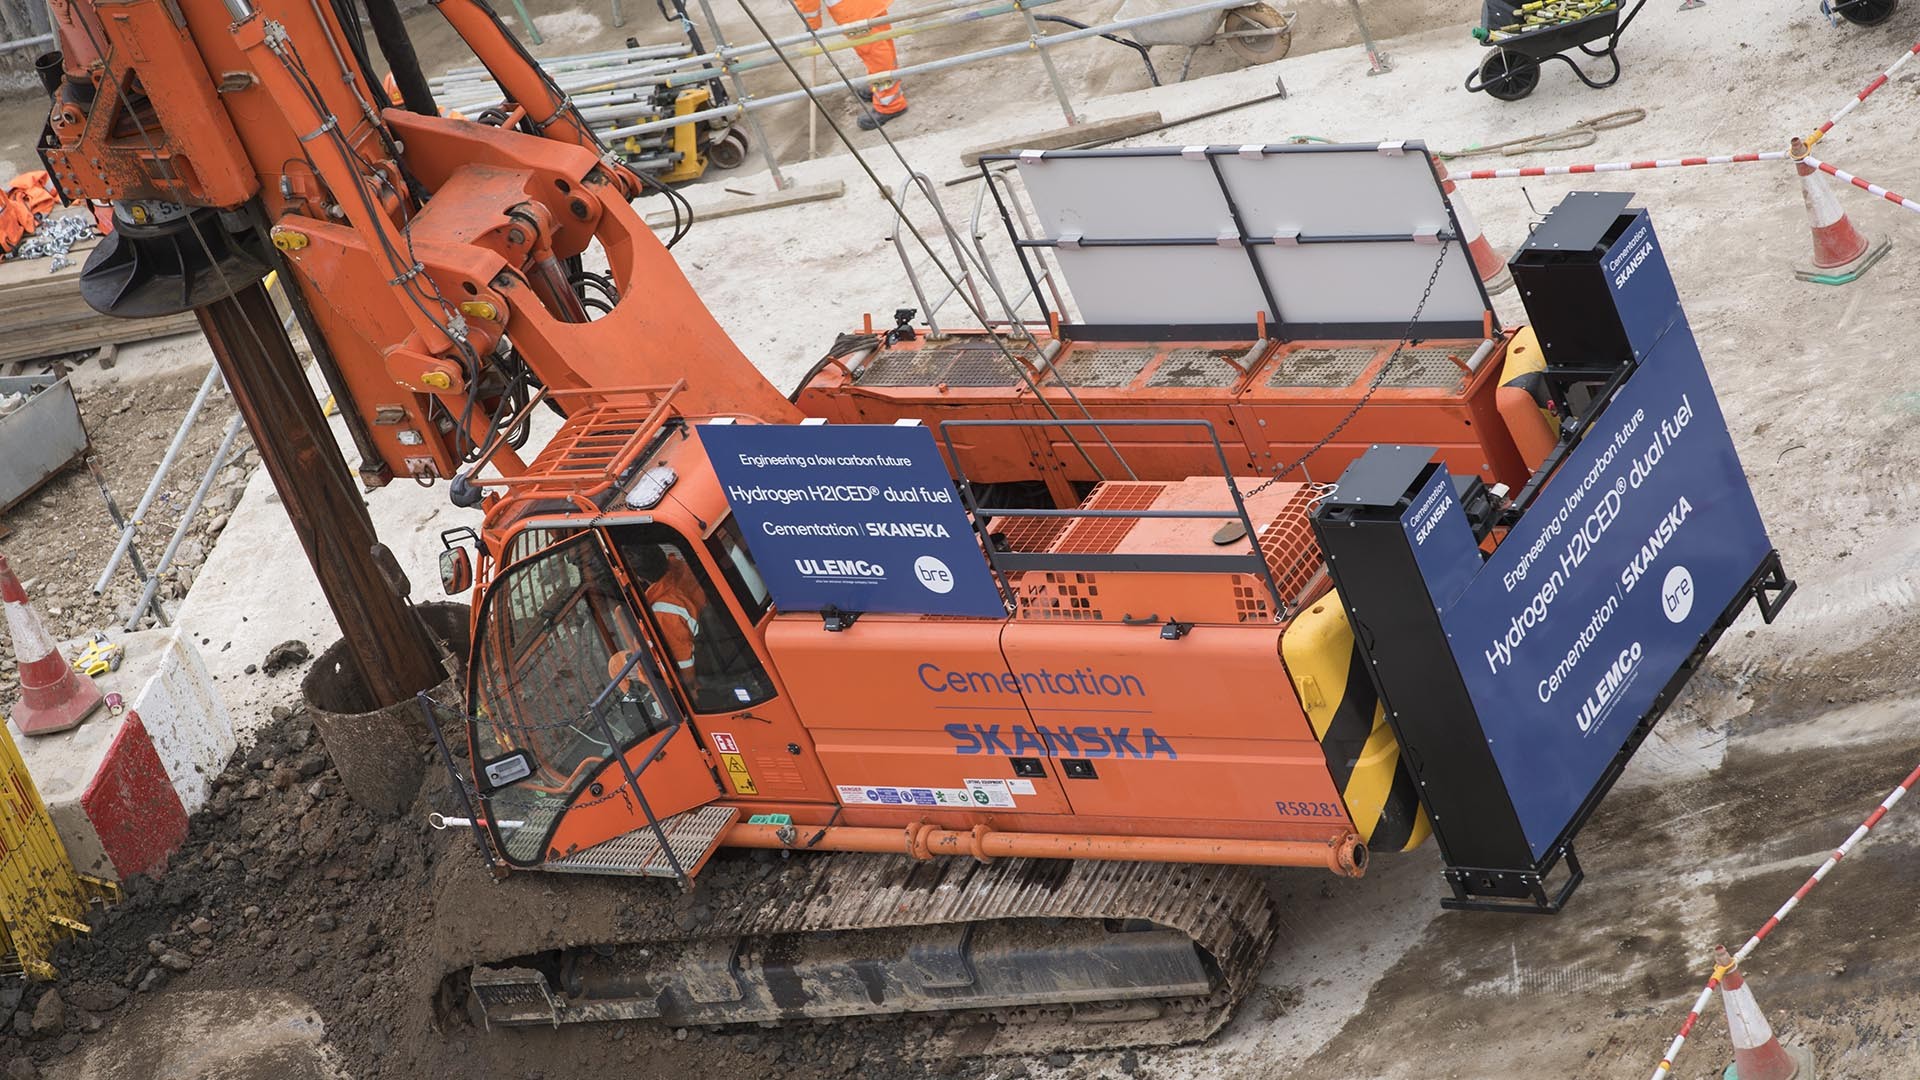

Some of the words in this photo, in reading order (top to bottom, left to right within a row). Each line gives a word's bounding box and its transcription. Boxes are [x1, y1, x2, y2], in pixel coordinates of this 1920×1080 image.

[1609, 226, 1647, 271] Cementation
[1615, 241, 1654, 290] SKANSKA
[738, 453, 807, 468] Engineering
[807, 457, 817, 466] a
[815, 454, 835, 466] low
[835, 455, 877, 467] carbon
[877, 455, 912, 467] future
[728, 485, 809, 505] Hydrogen
[884, 486, 919, 502] dual
[919, 487, 952, 503] fuel
[1410, 480, 1446, 528] Cementation
[1503, 516, 1562, 592] Engineering
[1559, 508, 1569, 522] a
[1565, 484, 1585, 512] low
[1583, 445, 1618, 490] carbon
[1615, 408, 1645, 448] future
[762, 521, 859, 536] Cementation
[865, 522, 951, 538] SKANSKA
[1415, 495, 1453, 546] SKANSKA
[1485, 570, 1564, 675] Hydrogen
[1629, 431, 1665, 489] dual
[1661, 394, 1694, 446] fuel
[794, 559, 885, 577] ULEMCo
[918, 565, 950, 582] bre
[1537, 595, 1619, 703] Cementation
[1620, 495, 1693, 593] SKANSKA
[1664, 578, 1691, 613] bre
[917, 662, 1146, 697] Cementation
[1576, 641, 1642, 732] ULEMCo
[944, 723, 1178, 760] SKANSKA
[1275, 801, 1343, 817] R58281
